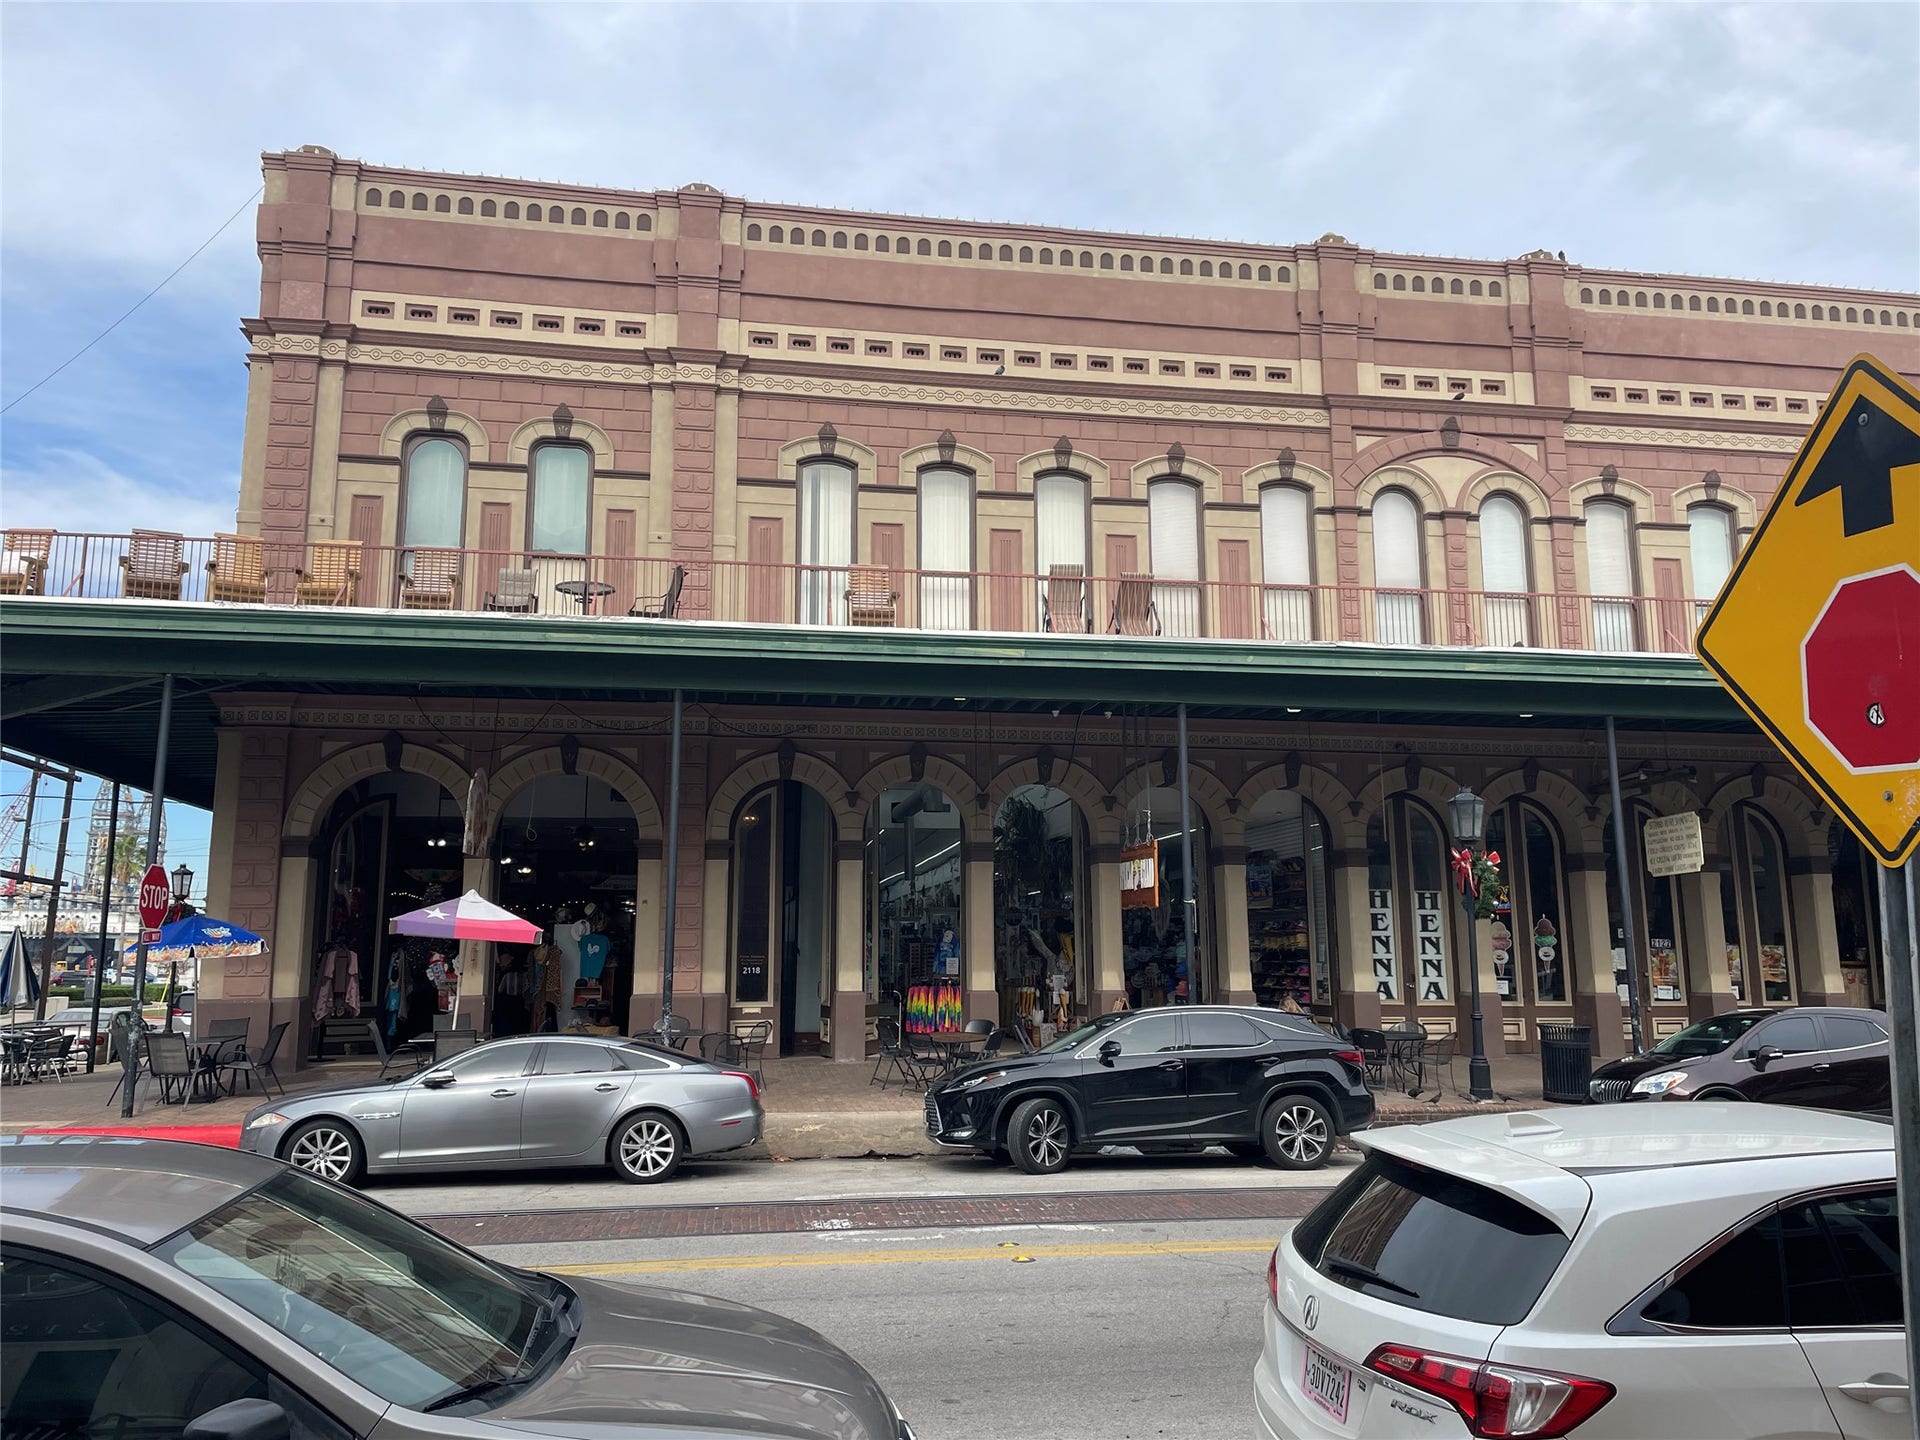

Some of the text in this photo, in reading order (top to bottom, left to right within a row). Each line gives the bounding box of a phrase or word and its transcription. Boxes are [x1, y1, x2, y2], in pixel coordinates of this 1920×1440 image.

[141, 884, 168, 910] STOP
[1369, 890, 1395, 1000] HENNA
[1416, 892, 1445, 1000] HENNA
[1651, 939, 1671, 948] 2122
[742, 966, 761, 974] 2118
[1316, 1353, 1339, 1375] TEXAS
[1390, 1399, 1438, 1425] RDX
